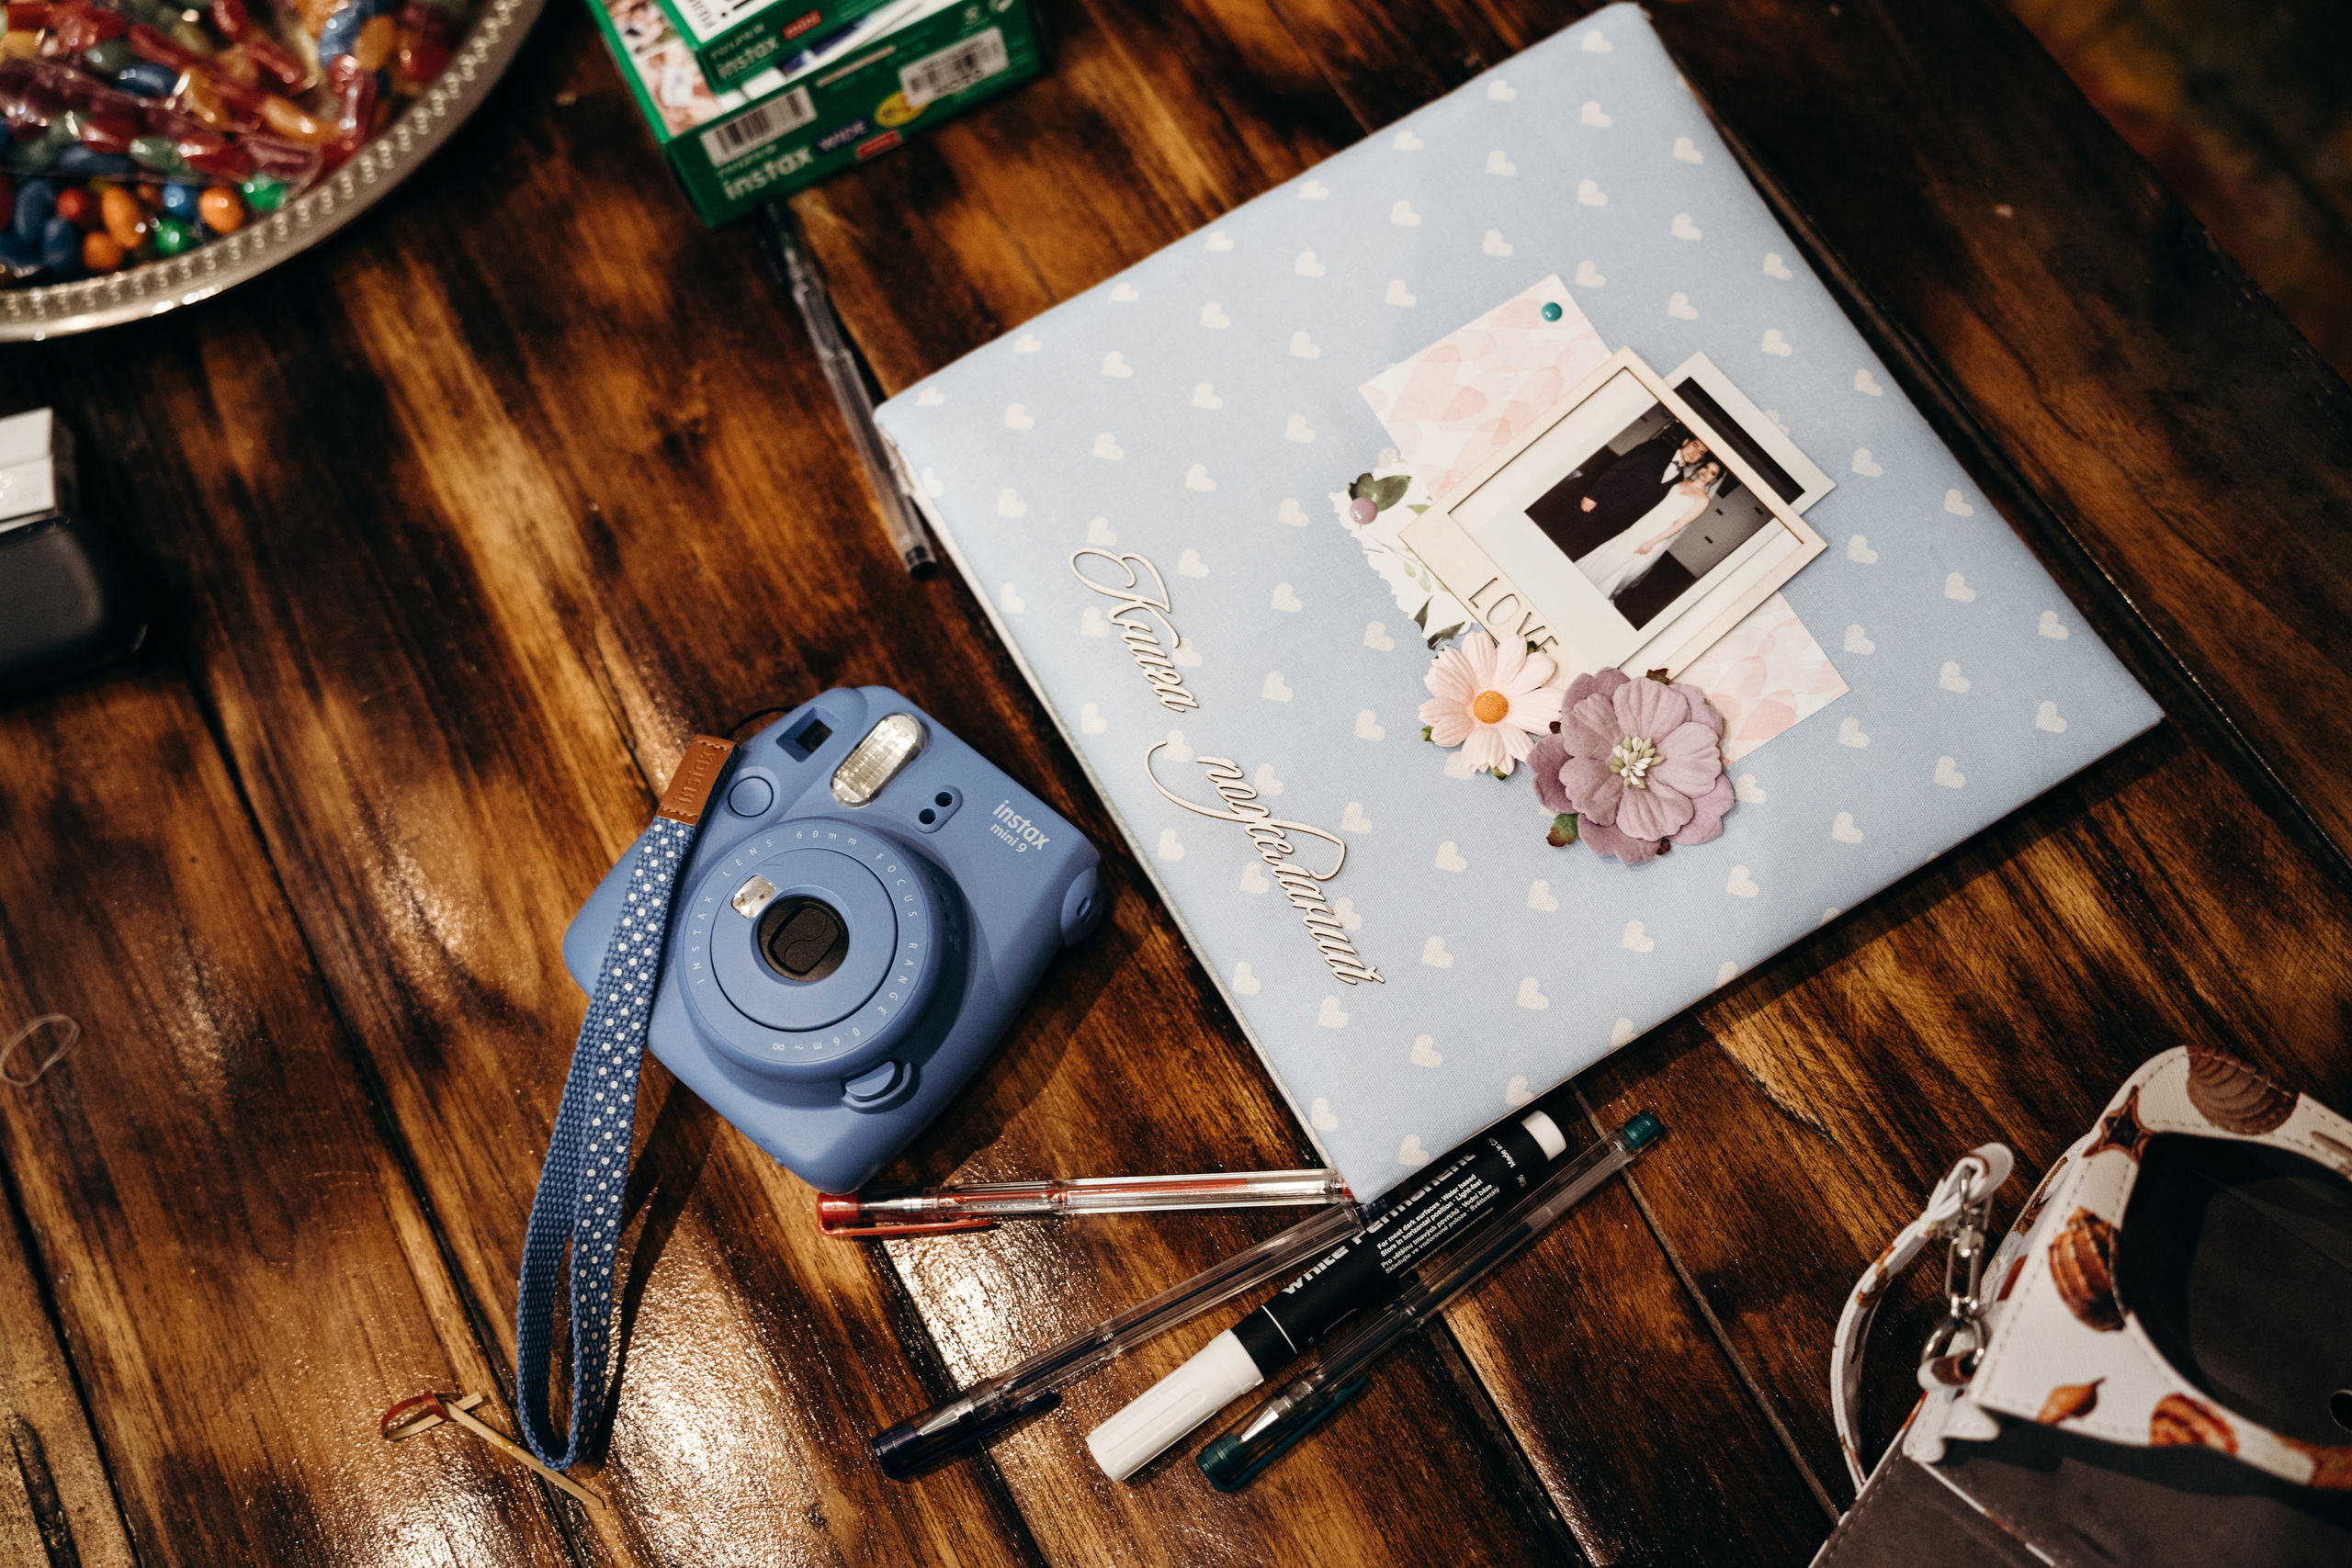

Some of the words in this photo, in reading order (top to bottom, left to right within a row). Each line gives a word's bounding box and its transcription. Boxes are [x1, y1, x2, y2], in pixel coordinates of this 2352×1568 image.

[723, 146, 814, 200] instax
[673, 750, 717, 805] instax
[1069, 548, 1198, 713] Книга
[1144, 740, 1385, 985] пожеланий
[989, 824, 1020, 847] mini
[1015, 842, 1028, 853] 9
[992, 799, 1051, 851] instax
[722, 840, 774, 878] LENS
[875, 852, 918, 918] FOCUS
[691, 896, 713, 984] INSTAX
[876, 942, 918, 1016] RANGE
[1496, 1144, 1504, 1152] in
[1500, 1149, 1517, 1168] Made
[1376, 1239, 1388, 1249] For
[1387, 1228, 1404, 1242] most
[1402, 1219, 1417, 1231] dark
[1415, 1201, 1440, 1221] surfaces
[1441, 1186, 1459, 1201] Water
[1457, 1173, 1476, 1189] based
[1379, 1243, 1396, 1257] Store
[1401, 1216, 1430, 1240] horizontal
[1430, 1201, 1453, 1221] position
[1454, 1178, 1483, 1201] Light-fast
[1380, 1258, 1392, 1268] Pro
[1391, 1242, 1413, 1259] většinu
[1412, 1225, 1437, 1245] tmavých
[1436, 1207, 1460, 1228] povrchů
[1461, 1192, 1479, 1207] Vodní
[1476, 1183, 1492, 1196] báze
[1385, 1253, 1411, 1273] Skladujte
[1419, 1224, 1448, 1248] vodorovné
[1448, 1212, 1466, 1228] poloze
